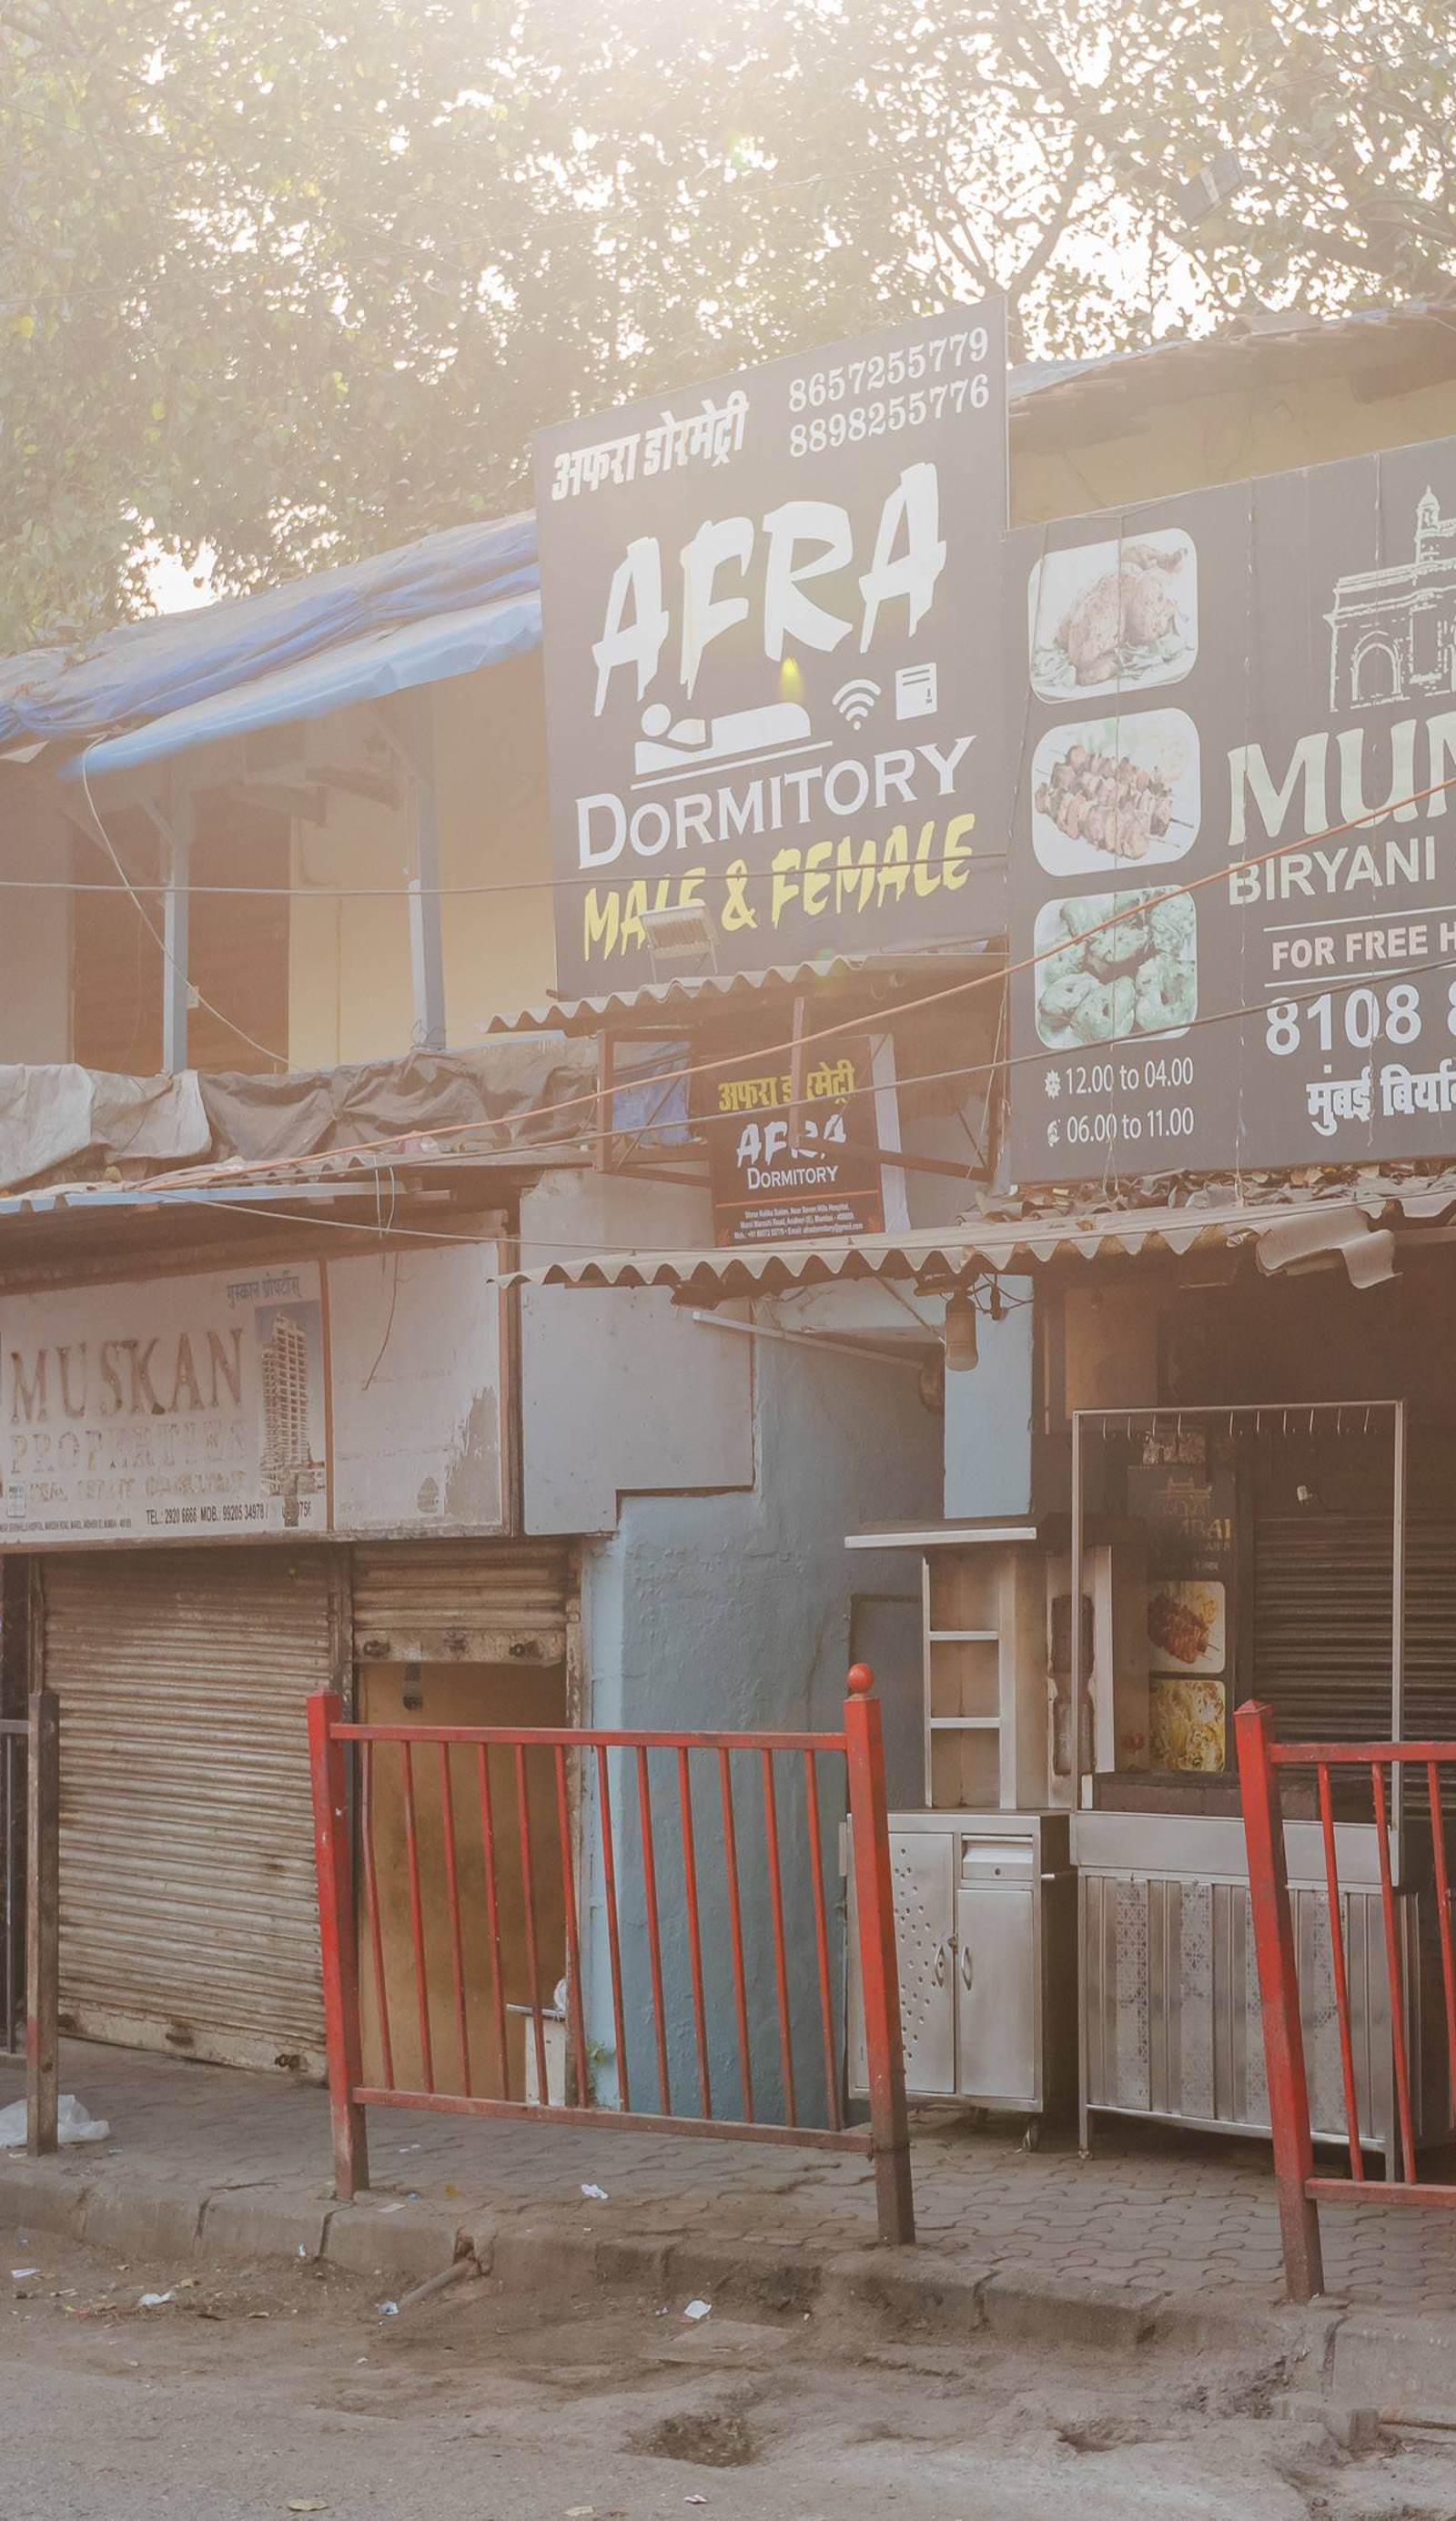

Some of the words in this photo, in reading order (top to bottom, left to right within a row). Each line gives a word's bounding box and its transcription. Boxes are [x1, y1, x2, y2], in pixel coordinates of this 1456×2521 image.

[789, 327, 988, 412] 8657255779
[790, 373, 989, 458] 8898255776
[551, 433, 641, 501] अफरा
[592, 462, 947, 716] AFRA
[721, 858, 759, 932] &
[771, 813, 976, 929] FEMALE
[1228, 835, 1435, 906] BIRYANI
[1272, 936, 1335, 971] FOR
[1346, 924, 1428, 963] FREE
[1266, 984, 1421, 1056] 8108
[718, 1077, 778, 1111] अफरा
[1066, 1064, 1114, 1095] 12.00
[1119, 1065, 1139, 1090] to
[1145, 1057, 1194, 1088] 04.00
[1067, 1113, 1117, 1143] 06.00
[1122, 1114, 1142, 1139] to
[1147, 1107, 1195, 1138] 11.00
[10, 1327, 243, 1425] MUSKAN
